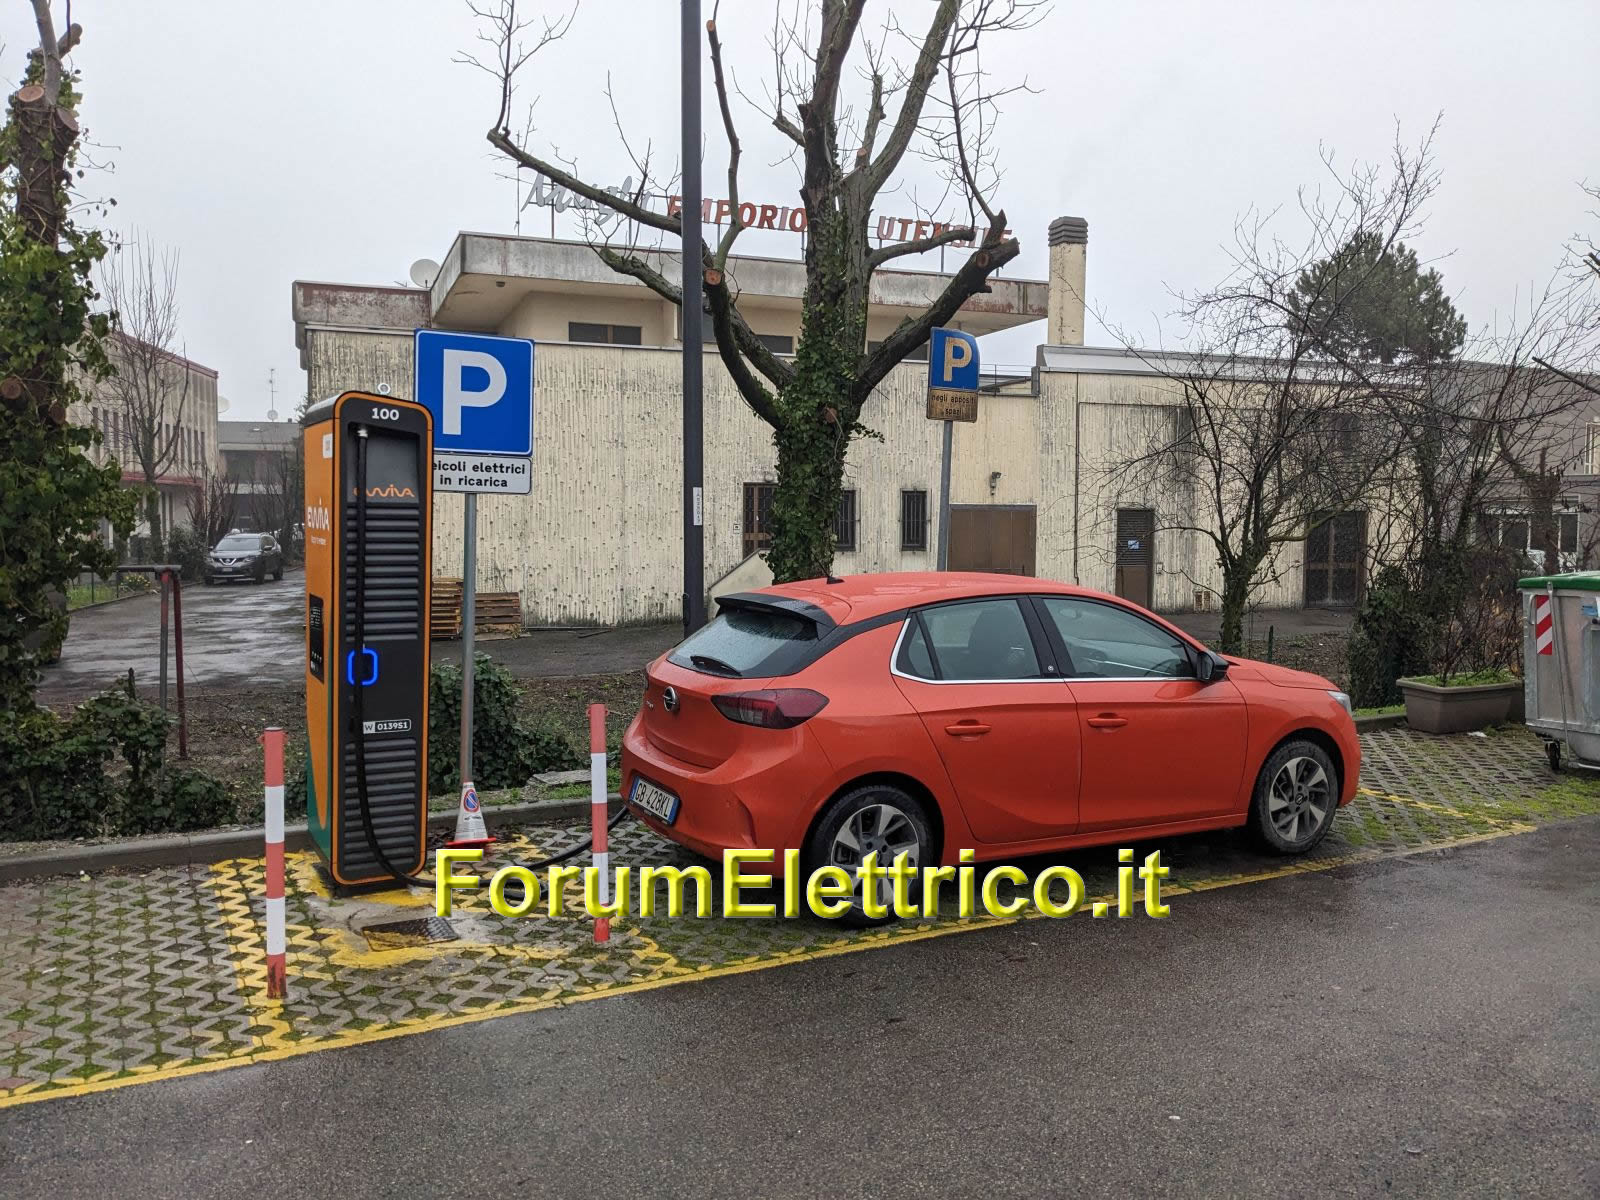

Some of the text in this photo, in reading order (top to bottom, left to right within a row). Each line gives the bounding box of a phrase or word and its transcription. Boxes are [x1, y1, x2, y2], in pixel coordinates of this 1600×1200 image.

[669, 195, 807, 232] EPORIO
[943, 336, 973, 382] P
[442, 348, 508, 436] P
[931, 394, 948, 403] negli
[371, 407, 400, 421] 100
[432, 460, 526, 475] eicoli elettrici
[439, 474, 508, 487] in ricarica
[364, 723, 374, 731] W
